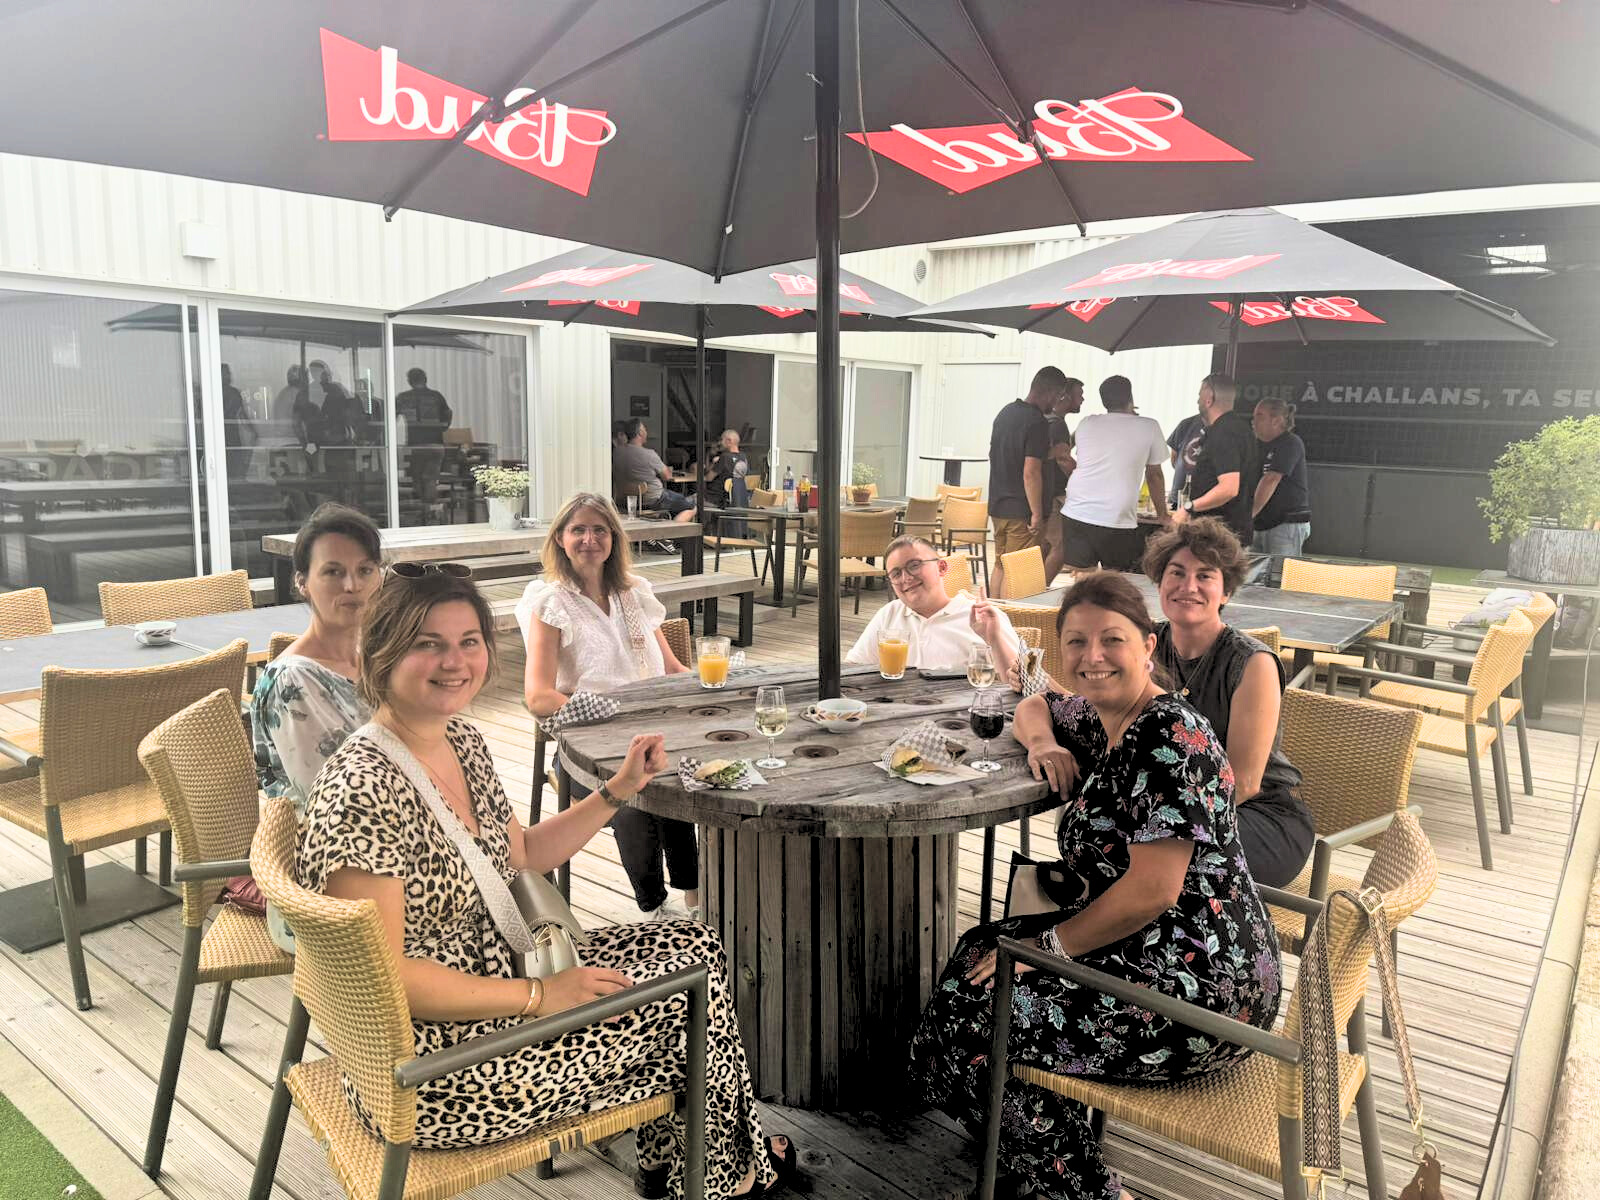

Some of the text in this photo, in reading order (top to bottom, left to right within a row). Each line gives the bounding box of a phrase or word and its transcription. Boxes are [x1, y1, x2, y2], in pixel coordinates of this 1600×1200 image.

[1099, 255, 1256, 282] Bud
[1301, 381, 1319, 402] À
[1326, 386, 1491, 409] CHALLANS,
[1503, 388, 1541, 407] TA
